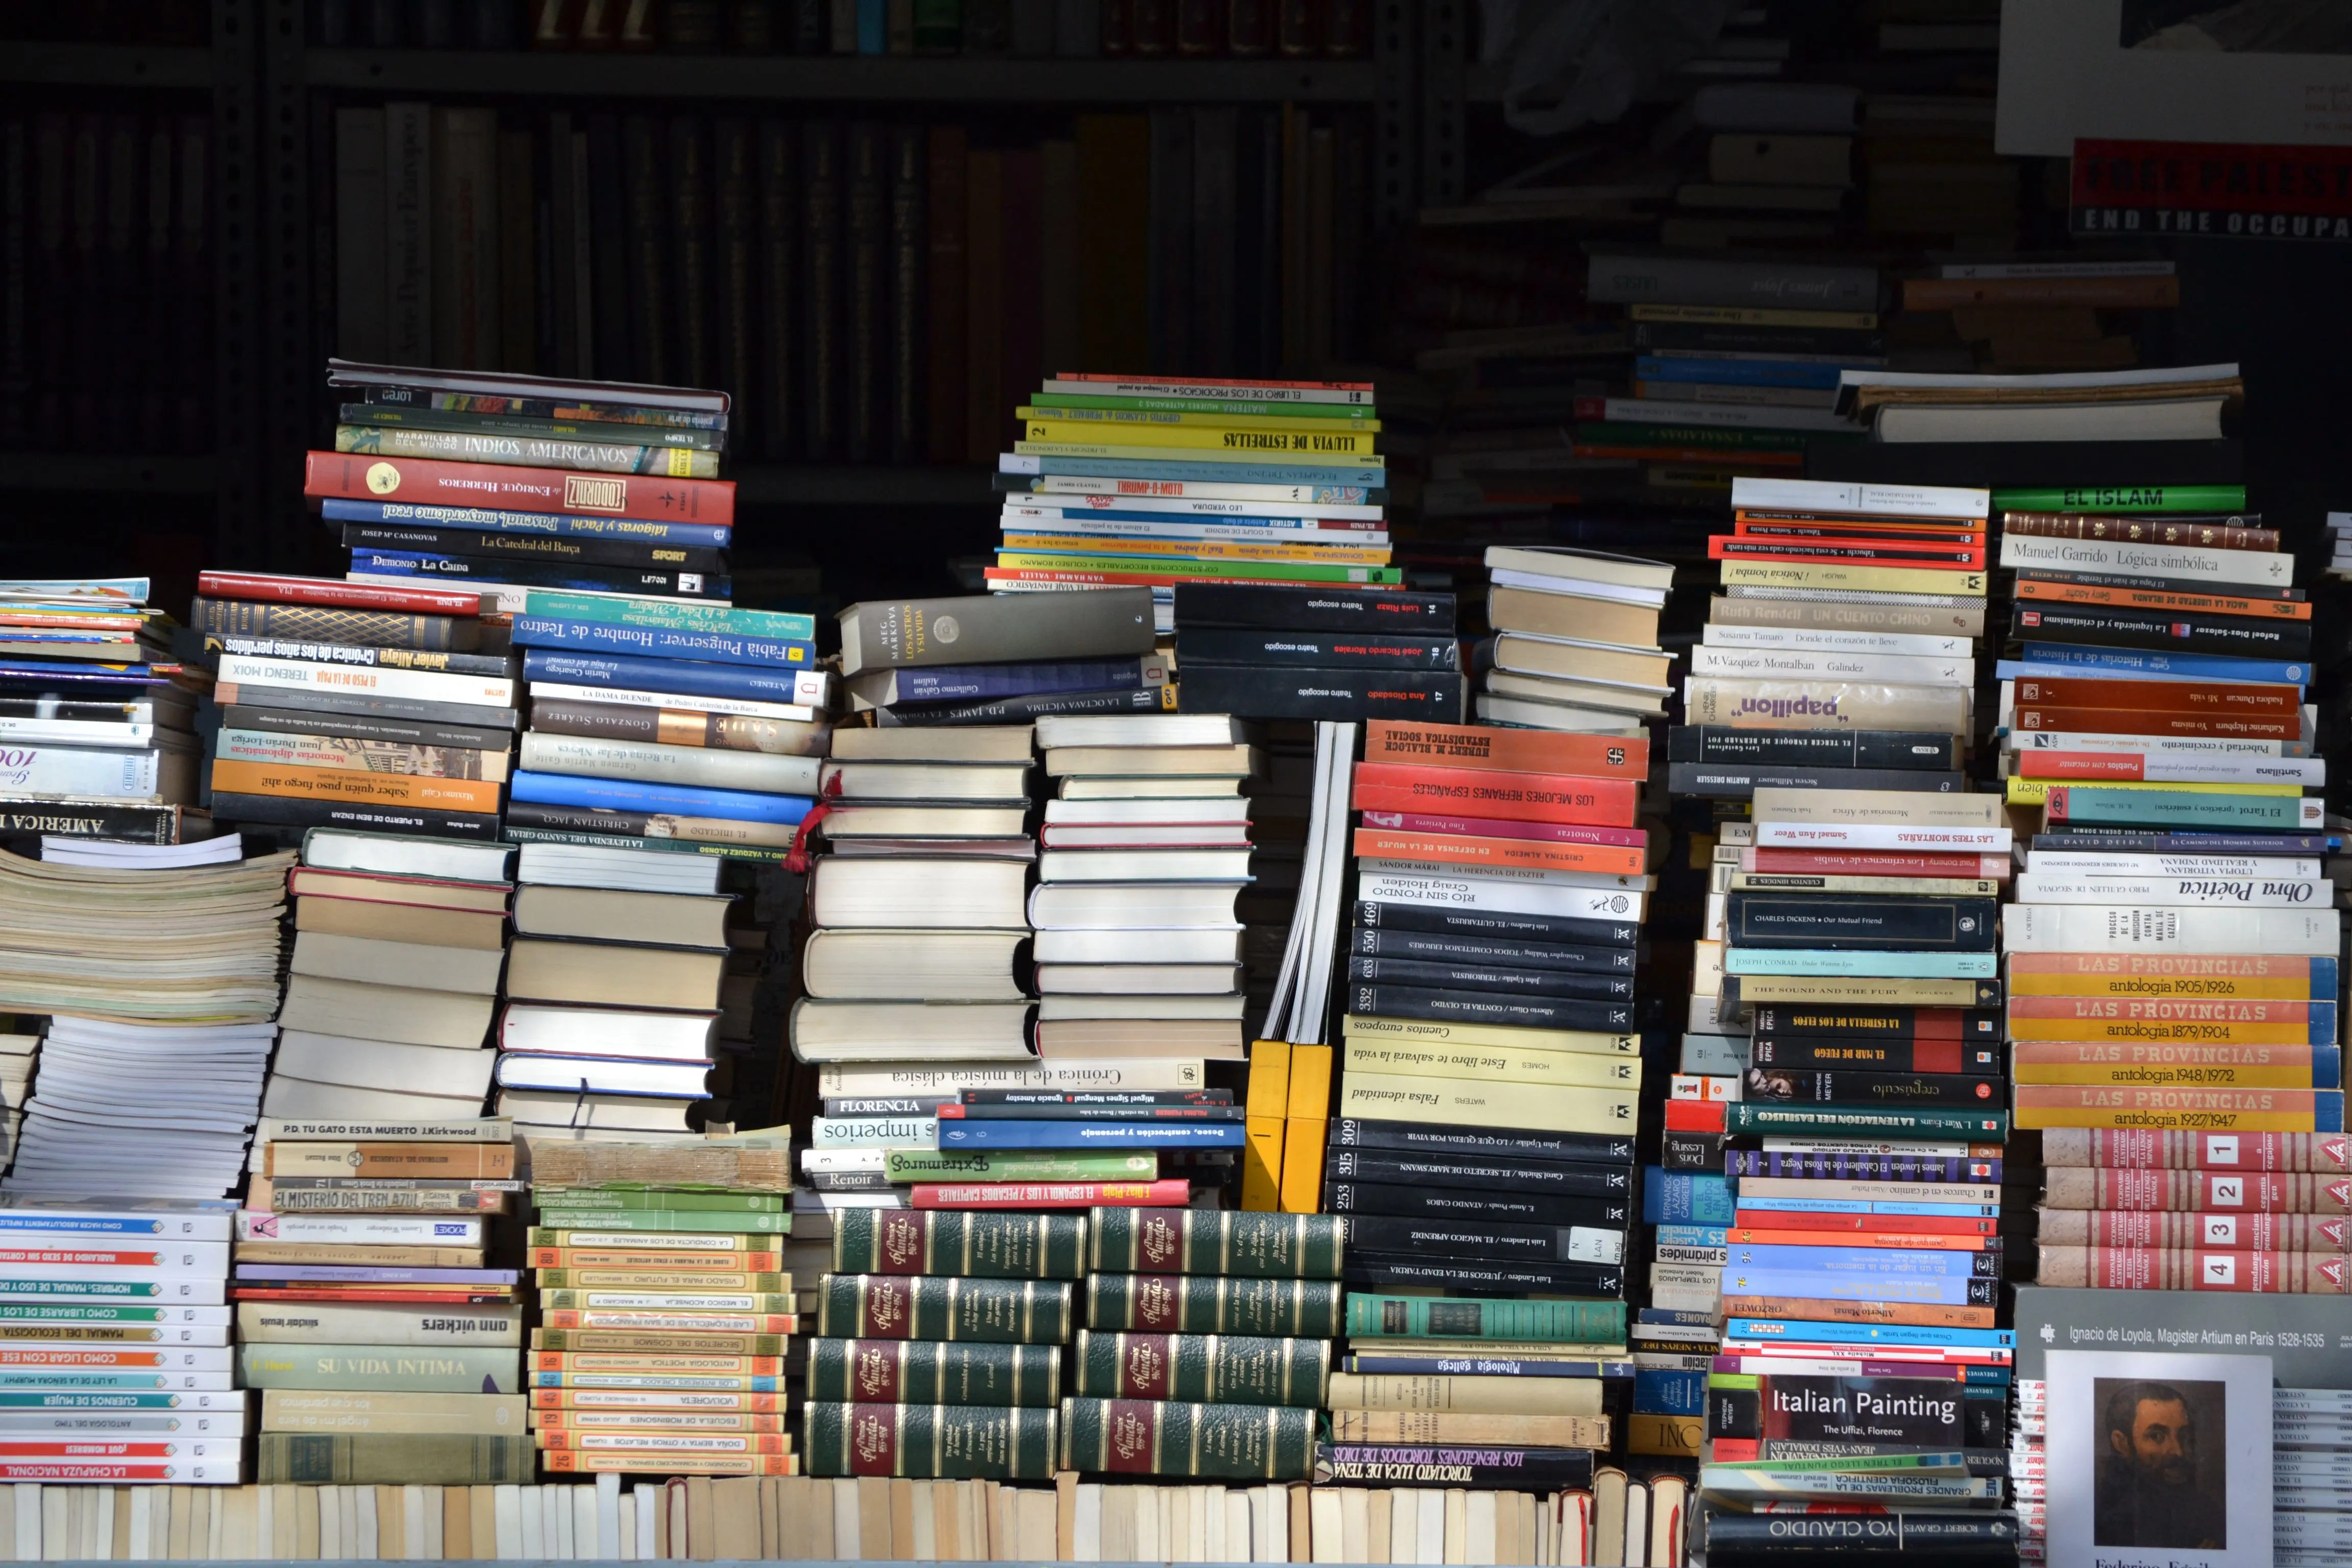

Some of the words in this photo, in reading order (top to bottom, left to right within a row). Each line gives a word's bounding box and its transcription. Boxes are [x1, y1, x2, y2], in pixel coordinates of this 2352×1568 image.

[2085, 209, 2139, 229] END
[2158, 211, 2209, 230] THE
[1178, 386, 1228, 397] PRODIGIOS
[1231, 388, 1248, 398] LOS
[1252, 389, 1263, 398] DE
[1265, 389, 1289, 399] LIBRO
[1292, 390, 1301, 399] EL
[1224, 433, 1287, 448] ESTRELLAS
[1292, 435, 1307, 449] DE
[1313, 436, 1354, 450] LLUVIA
[465, 437, 519, 454] INDIOS
[526, 442, 628, 462] AMERICANOS
[439, 478, 497, 492] HERREROS
[502, 482, 550, 496] ENRIQUE
[2064, 490, 2090, 504] EL
[2096, 489, 2163, 505] ISLAM
[382, 504, 413, 518] real
[414, 507, 497, 523] mayordomo
[498, 512, 558, 530] Pascual,
[570, 519, 604, 531] Pachi
[605, 519, 616, 531] y
[651, 550, 687, 561] SPORT
[2014, 543, 2058, 558] Manuel
[2062, 546, 2107, 562] Garrido
[2117, 550, 2157, 569] Lógica
[2161, 554, 2217, 571] simbólica
[520, 620, 565, 638] Teatro
[571, 625, 588, 639] de
[594, 627, 653, 646] Hombre
[659, 634, 742, 655] Puigserver:
[747, 643, 786, 659] Fabià
[232, 664, 261, 677] MOIX
[264, 667, 308, 680] TERENCI
[1297, 687, 1330, 697] escogido
[1330, 689, 1353, 698] Teatro
[2215, 721, 2247, 732] Hepburn
[2248, 723, 2285, 733] Katharine
[2161, 741, 2216, 751] crecimiento
[2218, 741, 2224, 750] y
[2226, 743, 2269, 754] Pubertad
[230, 746, 294, 759] diplomáticas
[296, 751, 345, 764] Memorias
[1696, 775, 1725, 783] DRESSLER
[2256, 768, 2301, 777] Santillana
[261, 777, 282, 788] ahí!
[284, 777, 313, 791] fuego
[315, 780, 342, 791] puso
[1727, 776, 1750, 784] MARTIN
[345, 783, 374, 795] quién
[376, 787, 409, 799] ¡Saber
[1413, 783, 1468, 797] ESPAÑOLES
[1473, 787, 1522, 801] REFRANES
[1526, 791, 1571, 804] MEJORES
[1575, 794, 1595, 806] LOS
[331, 811, 355, 819] ENZAR
[384, 816, 413, 825] PUERTO
[540, 813, 569, 825] JACQ
[573, 818, 629, 831] CHRISTIAN
[507, 829, 535, 839] GRIAL
[536, 832, 567, 841] SANTO
[568, 835, 586, 843] DEL
[1897, 833, 1950, 843] MONTAÑAS
[1951, 834, 1975, 843] TRES
[1976, 835, 1994, 843] LAS
[587, 835, 630, 847] LEYENDA
[631, 839, 643, 848] LA
[1382, 878, 1429, 889] Holden
[1432, 879, 1468, 892] Craig
[1371, 887, 1423, 898] FONDO
[1425, 891, 1448, 900] SIN
[2179, 881, 2253, 900] Poética
[2262, 883, 2313, 902] Obra
[1451, 893, 1476, 903] RÍO
[1353, 1020, 1403, 1033] europeos
[1793, 1016, 1817, 1026] ELFOS
[1819, 1017, 1833, 1026] LOS
[1835, 1017, 1846, 1026] DE
[1849, 1018, 1886, 1028] ESTRELLA
[1889, 1019, 1899, 1028] LA
[1407, 1024, 1450, 1037] Cuentos
[892, 1071, 943, 1085] clásica
[954, 1071, 1004, 1085] música
[1018, 1070, 1032, 1085] la
[1035, 1070, 1051, 1085] de
[1058, 1069, 1120, 1084] Crónica
[1872, 1079, 1939, 1097] crepúsculo
[1351, 1089, 1406, 1102] identidad
[1408, 1092, 1439, 1105] Falsa
[2080, 1092, 2123, 1107] LAS
[2135, 1093, 2272, 1110] PROVINCIAS
[839, 1099, 920, 1113] FLORENCIA
[2180, 1113, 2236, 1128] 1927/1947
[824, 1120, 917, 1142] imperios
[1080, 1128, 1125, 1138] personaje
[1126, 1128, 1134, 1136] y
[1136, 1129, 1191, 1138] construcción
[1193, 1128, 1224, 1137] Deseo,
[1671, 1140, 1704, 1154] Lessing
[2213, 1146, 2231, 1155] 1
[1678, 1154, 1704, 1165] Doris
[1891, 1162, 1920, 1173] Lowden
[1920, 1163, 1945, 1174] James
[828, 1172, 872, 1185] Renoir
[1336, 1184, 1350, 1209] 253
[2218, 1185, 2236, 1197] 2
[2211, 1223, 2229, 1236] 3
[891, 1217, 906, 1266] Planeta
[1660, 1248, 1716, 1262] pirámides
[2210, 1263, 2227, 1276] 4
[422, 1319, 475, 1333] vickers
[479, 1319, 507, 1332] ann
[2070, 1326, 2103, 1343] Ignacio
[2106, 1326, 2119, 1341] de
[2121, 1327, 2154, 1344] Loyola,
[2158, 1328, 2198, 1346] Magister
[2200, 1329, 2232, 1344] Artium
[2234, 1333, 2247, 1345] en
[2250, 1331, 2273, 1345] París
[2277, 1332, 2324, 1347] 1528-1535
[317, 1358, 340, 1374] SU
[347, 1359, 390, 1374] VIDA
[1774, 1388, 1846, 1413] Italian
[1857, 1392, 1955, 1424] Painting
[1823, 1424, 1839, 1434] The
[1841, 1425, 1865, 1436] Uffizi,
[1867, 1426, 1903, 1436] Florence
[6, 1464, 59, 1476] NACIONAL
[61, 1465, 111, 1476] CHAPUZA
[112, 1465, 126, 1477] LA
[1333, 1462, 1362, 1478] TENA
[1365, 1463, 1382, 1479] DE
[1384, 1463, 1414, 1480] LUCA
[1416, 1464, 1472, 1482] TORCUATO
[1770, 1521, 1862, 1536] CLAUDIO
[1867, 1521, 1896, 1536] YO,
